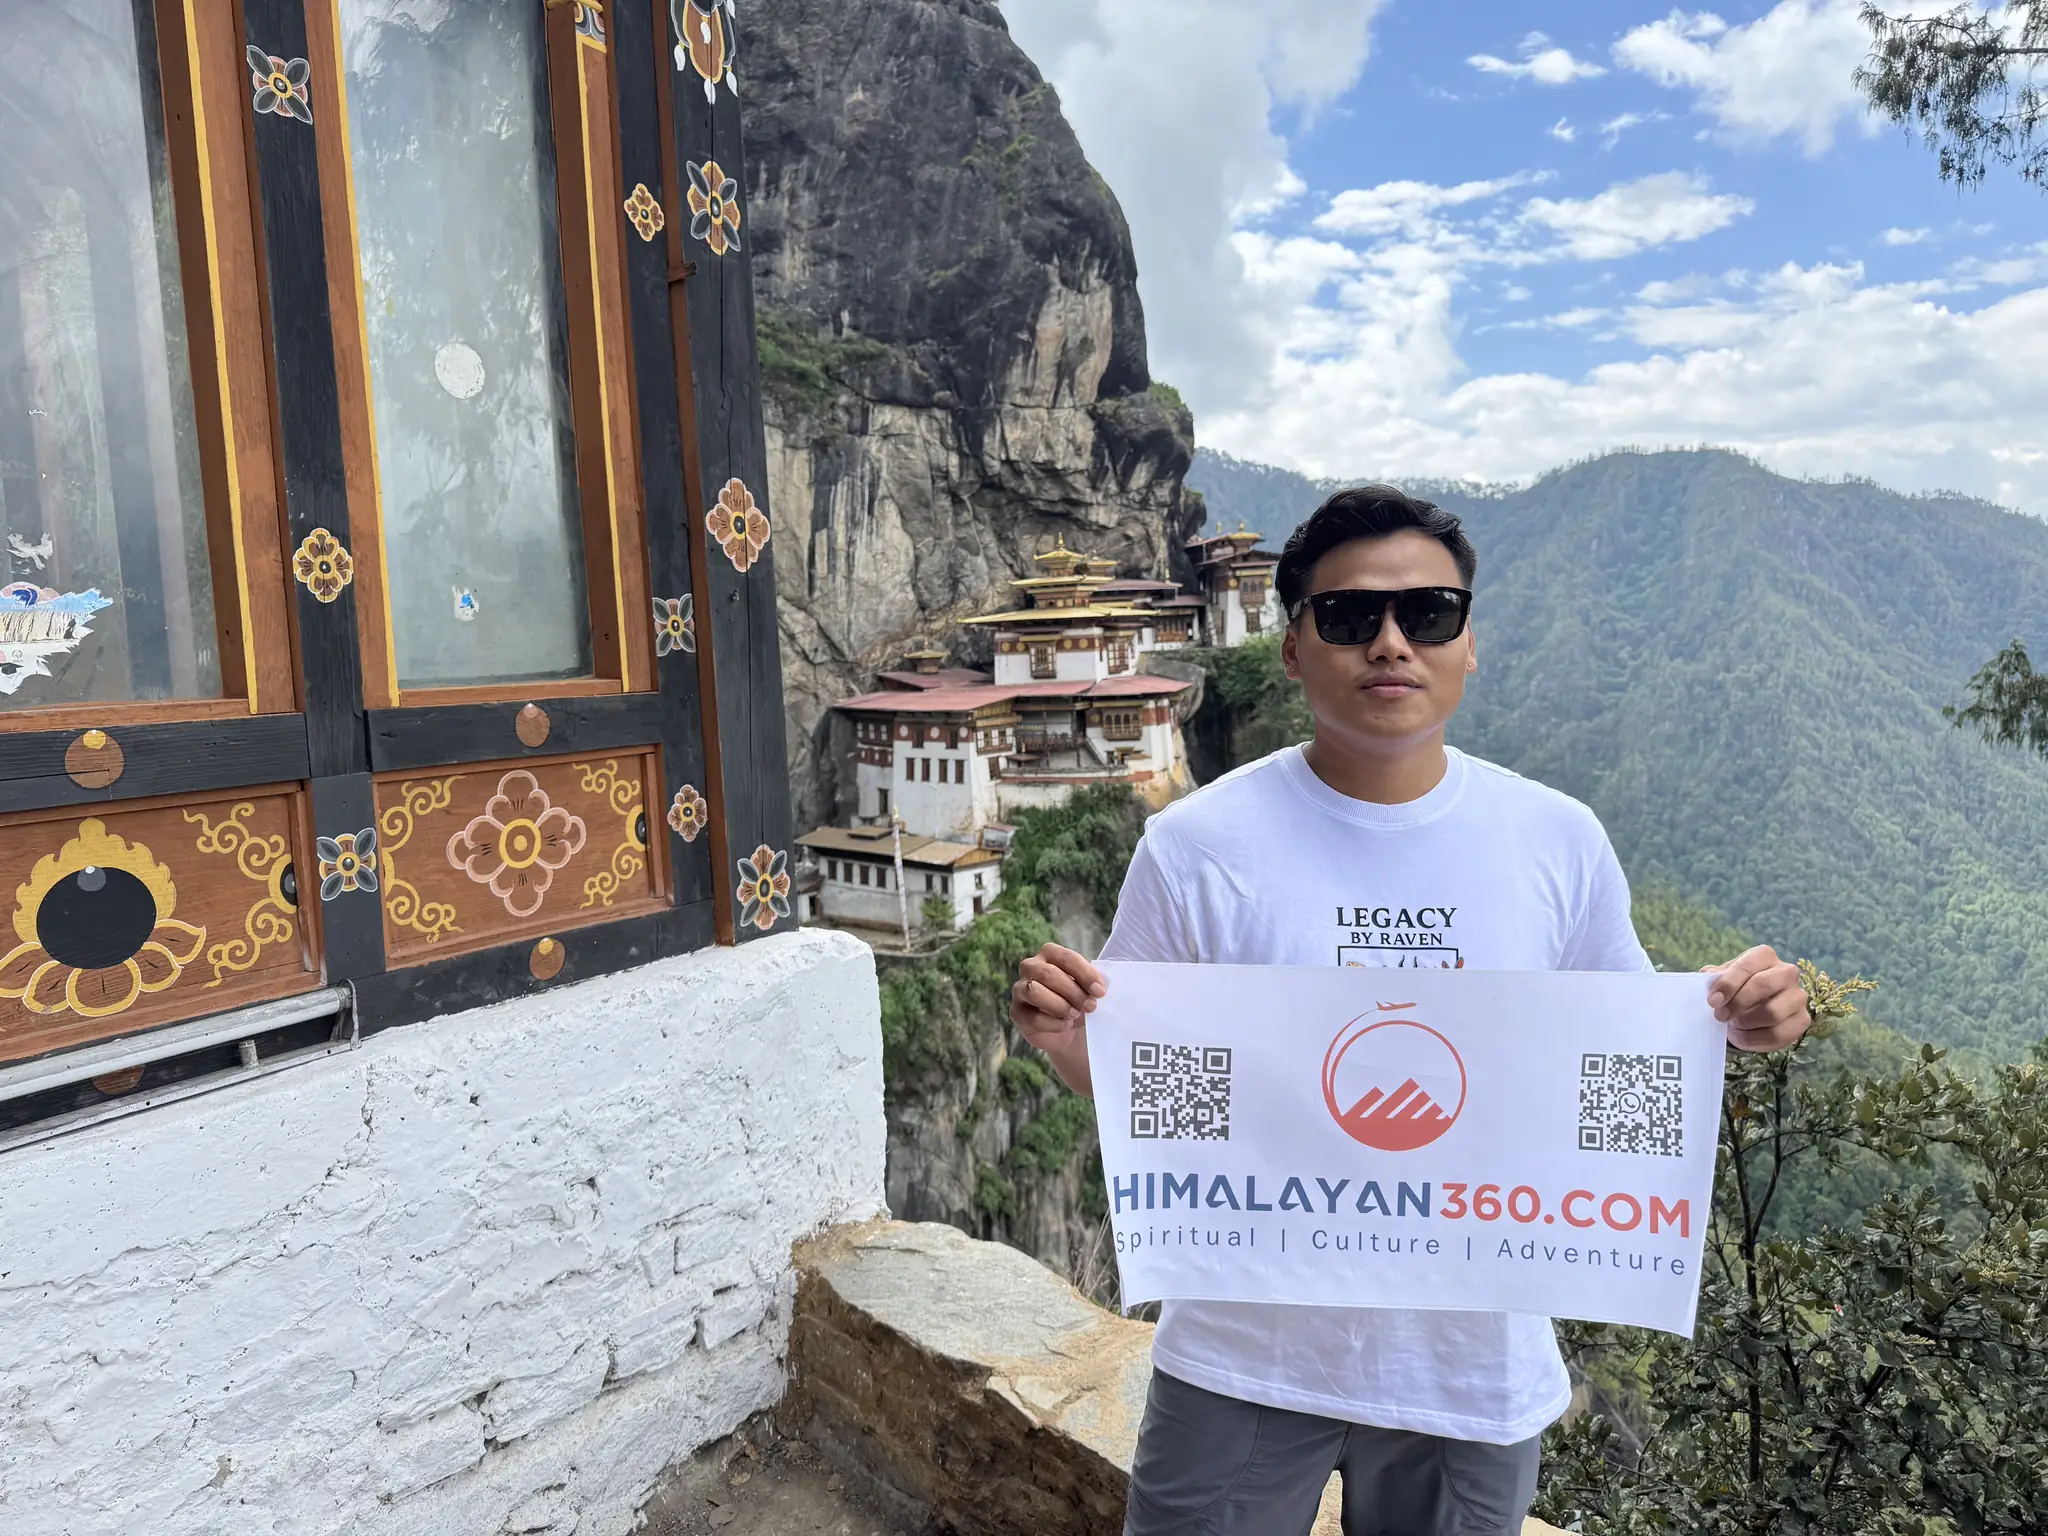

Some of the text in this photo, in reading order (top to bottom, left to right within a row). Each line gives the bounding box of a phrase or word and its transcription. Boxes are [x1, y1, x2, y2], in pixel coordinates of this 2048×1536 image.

[1336, 906, 1457, 929] LEGACY
[1350, 931, 1442, 946] BY RAVEN
[1113, 1172, 1690, 1239] HIMALAYAN360.COM
[1116, 1225, 1254, 1253] Spiritual
[1311, 1229, 1440, 1255] Culture
[1497, 1238, 1686, 1276] Adventure
